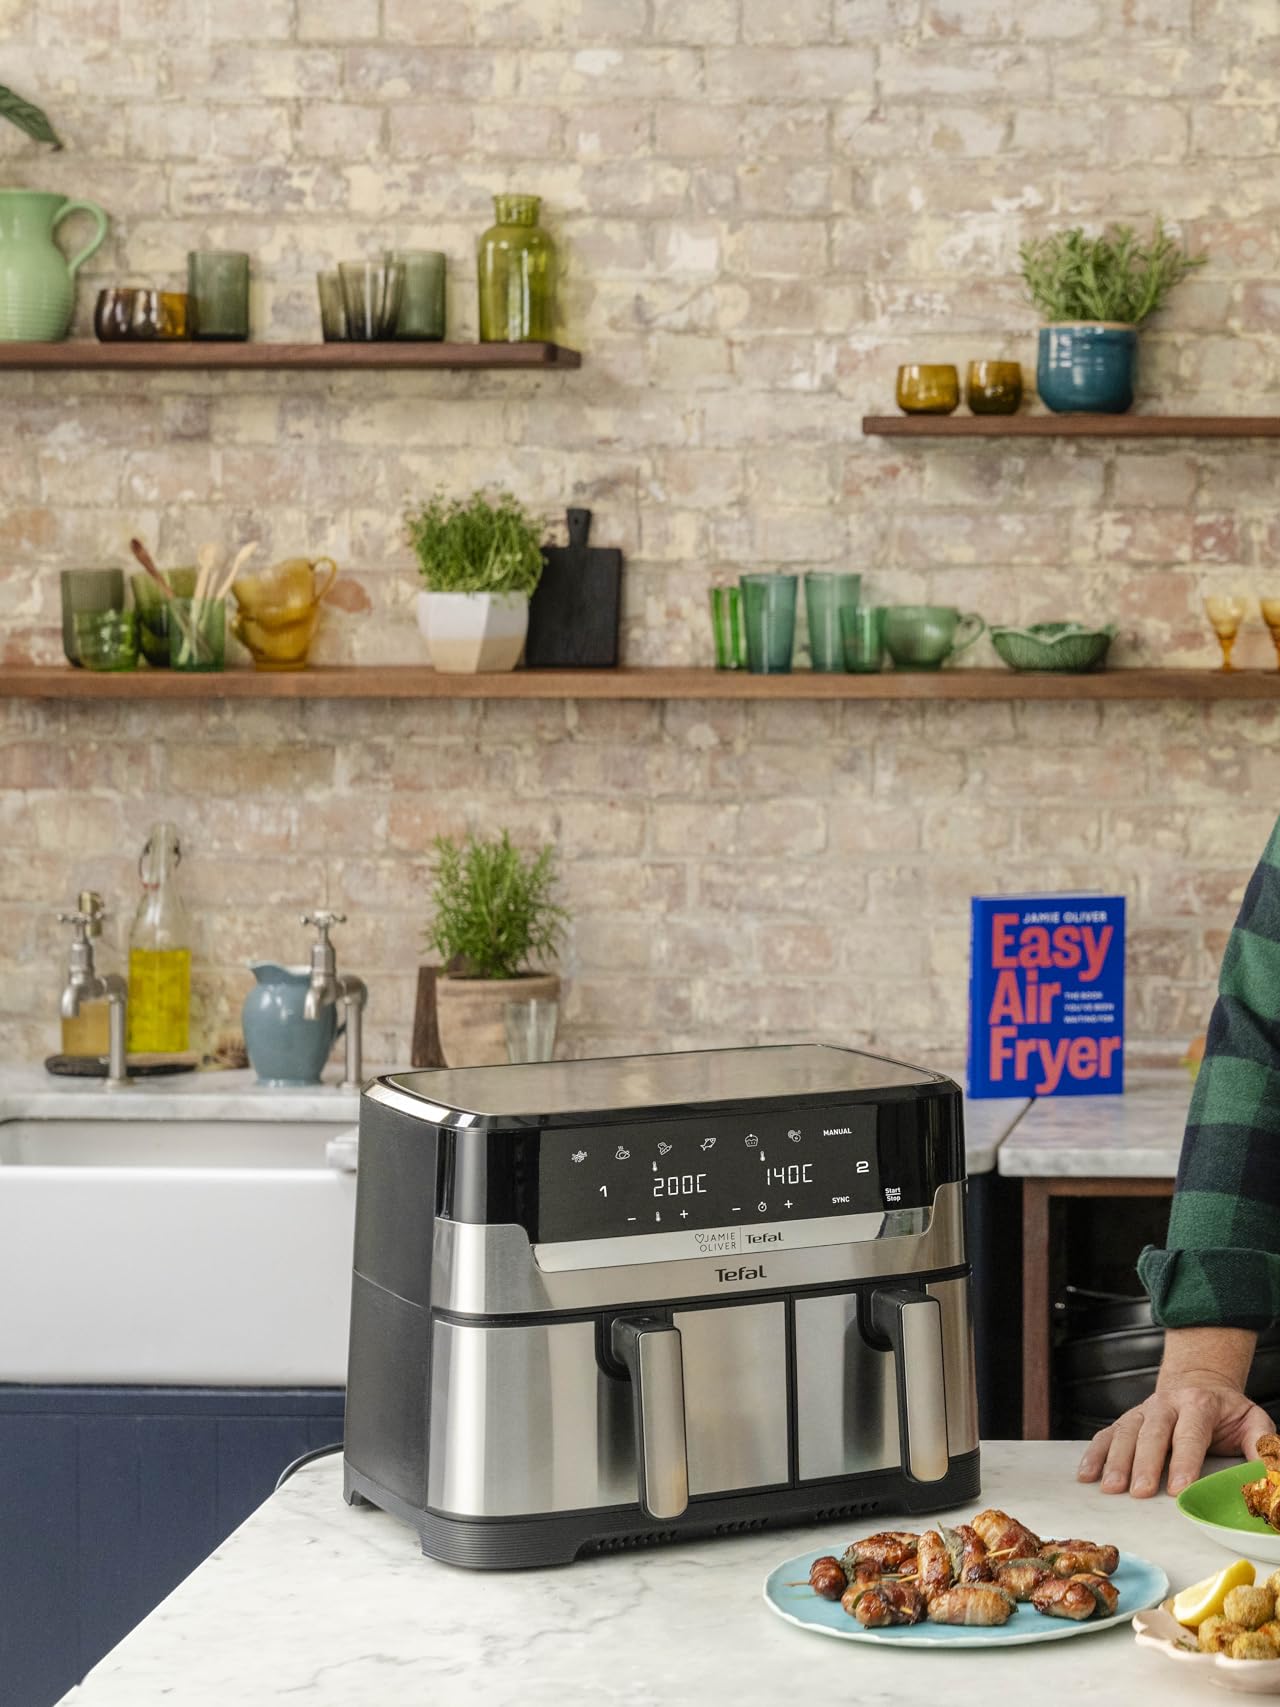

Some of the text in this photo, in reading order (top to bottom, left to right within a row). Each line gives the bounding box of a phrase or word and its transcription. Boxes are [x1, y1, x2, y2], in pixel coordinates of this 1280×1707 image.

[1023, 911, 1107, 924] JAMIE OLIVER
[992, 913, 1113, 982] Easy
[988, 969, 1061, 1024] Air
[989, 1025, 1121, 1095] Fryer
[823, 1128, 853, 1137] MANUAL
[856, 1160, 870, 1174] 2
[767, 1163, 813, 1186] 140C
[599, 1185, 608, 1198] 1
[653, 1173, 707, 1197] 200C
[832, 1196, 850, 1204] SYNC
[886, 1195, 901, 1203] Stop
[704, 1232, 736, 1243] JAMIE
[745, 1231, 785, 1244] Tefal
[699, 1241, 737, 1253] OLIVER
[714, 1265, 768, 1283] Tefal
